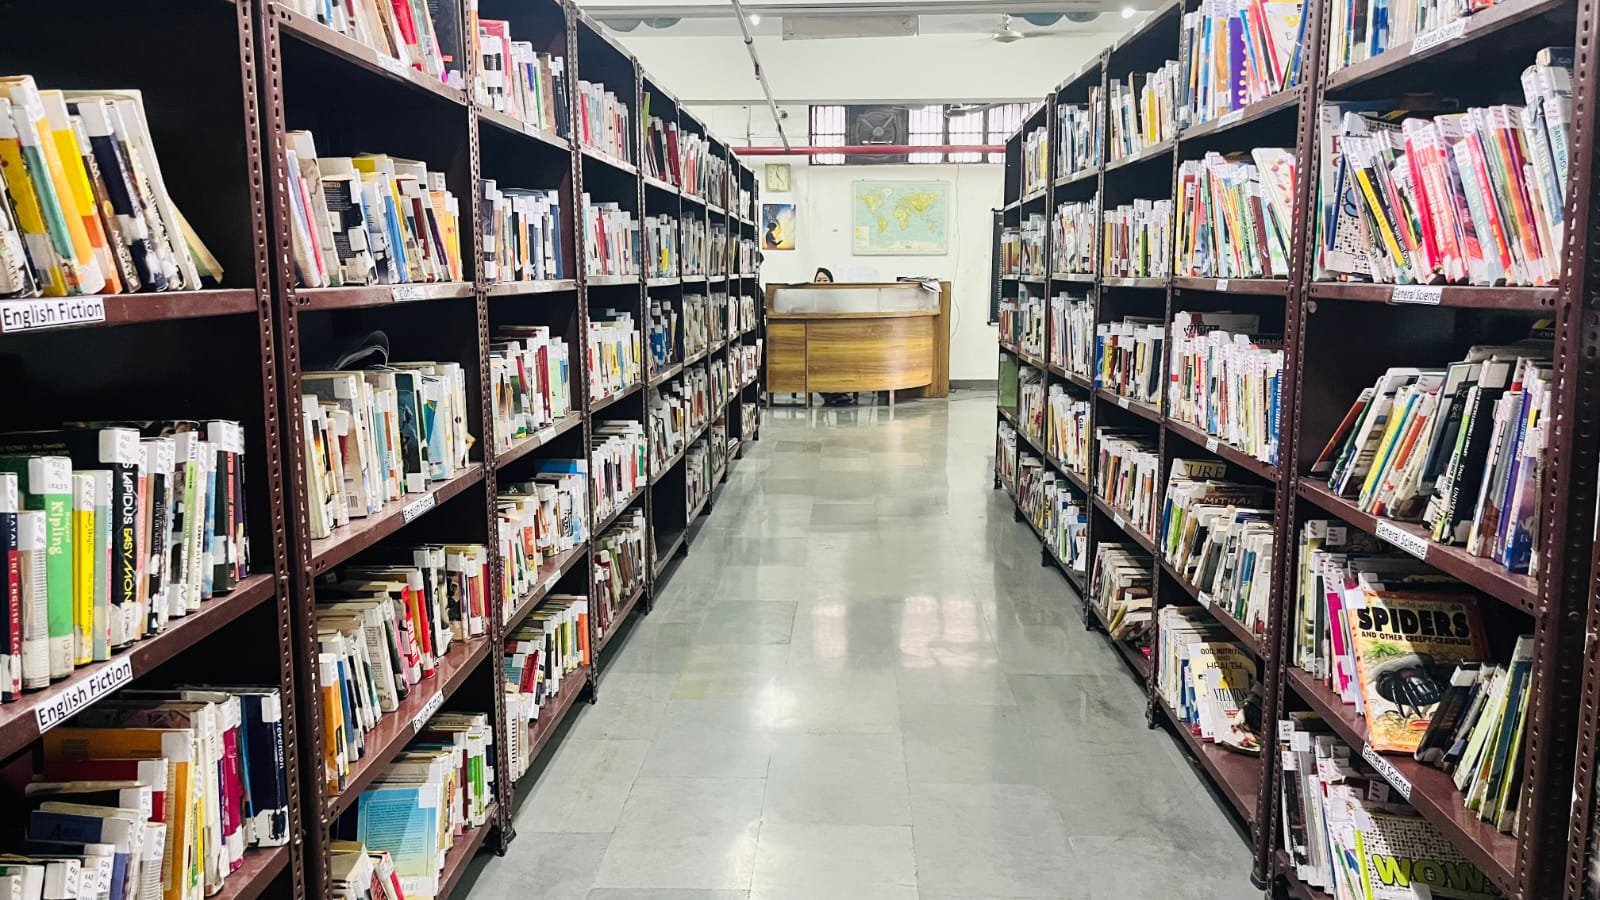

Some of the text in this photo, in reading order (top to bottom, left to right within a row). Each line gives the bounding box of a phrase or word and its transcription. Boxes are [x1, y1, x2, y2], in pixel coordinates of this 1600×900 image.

[1394, 287, 1440, 301] General Science
[3, 301, 103, 328] English Fiction
[124, 472, 134, 524] LAPIDUS
[48, 501, 64, 556] Kipling
[124, 527, 134, 559] EASY
[1377, 522, 1425, 556] General Science
[1357, 606, 1470, 638] SPIDERS
[1380, 633, 1403, 641] OTHER
[38, 661, 131, 728] English Fiction
[1363, 744, 1411, 796] General Science
[1371, 853, 1485, 894] WOW
